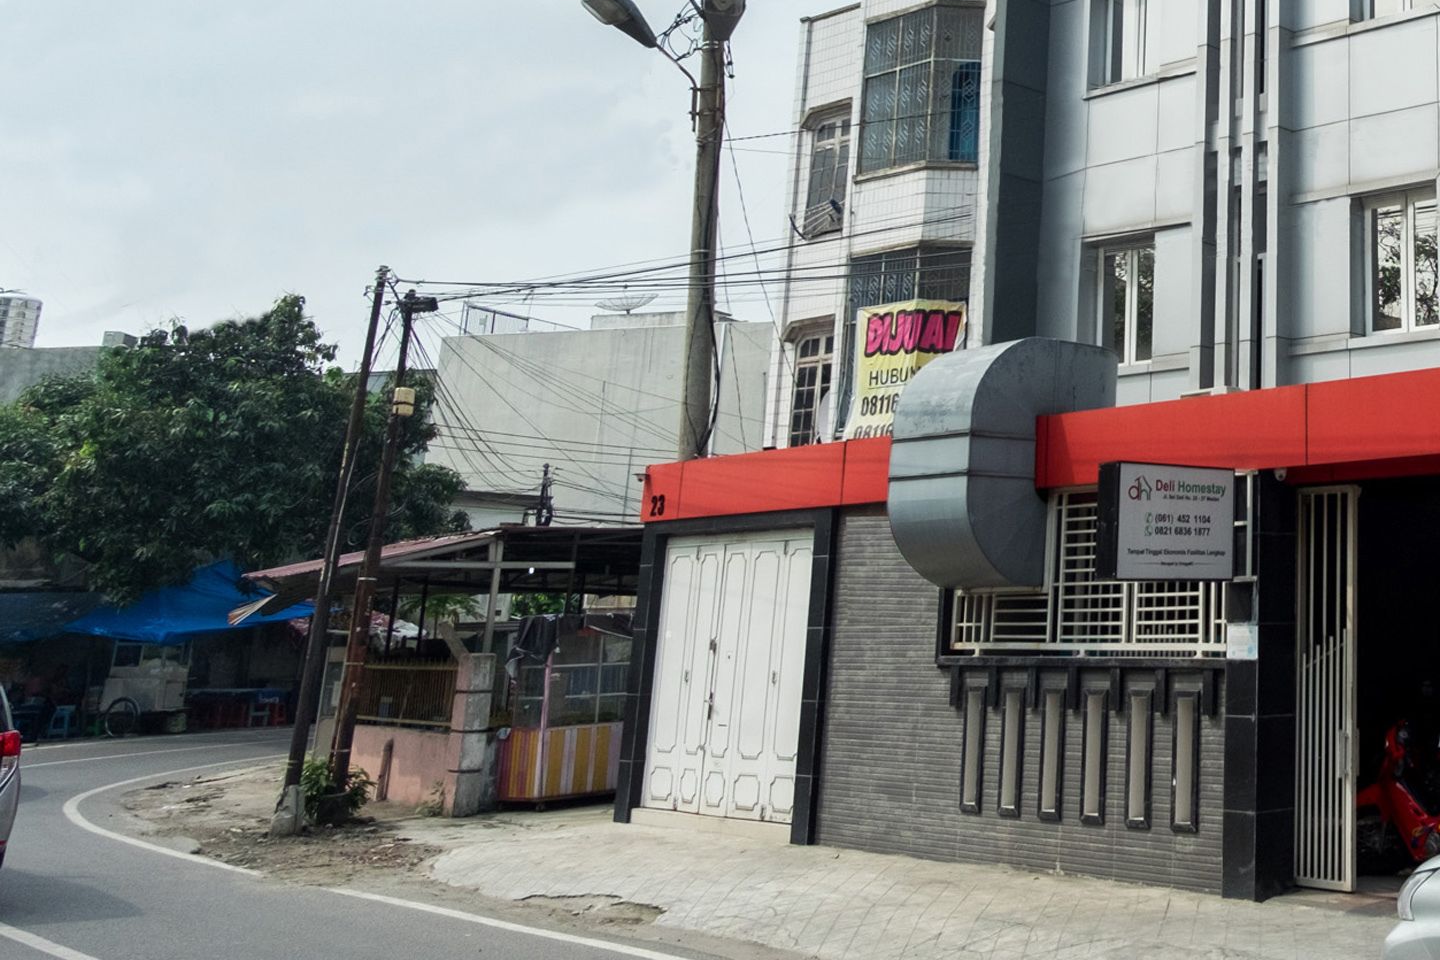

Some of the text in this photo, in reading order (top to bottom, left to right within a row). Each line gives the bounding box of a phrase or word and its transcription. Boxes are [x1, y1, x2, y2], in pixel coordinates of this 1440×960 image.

[1155, 479, 1226, 497] Deli Homestay
[649, 494, 665, 517] 23
[1154, 513, 1211, 524] (061) 452 1104
[1154, 526, 1172, 535] 0821
